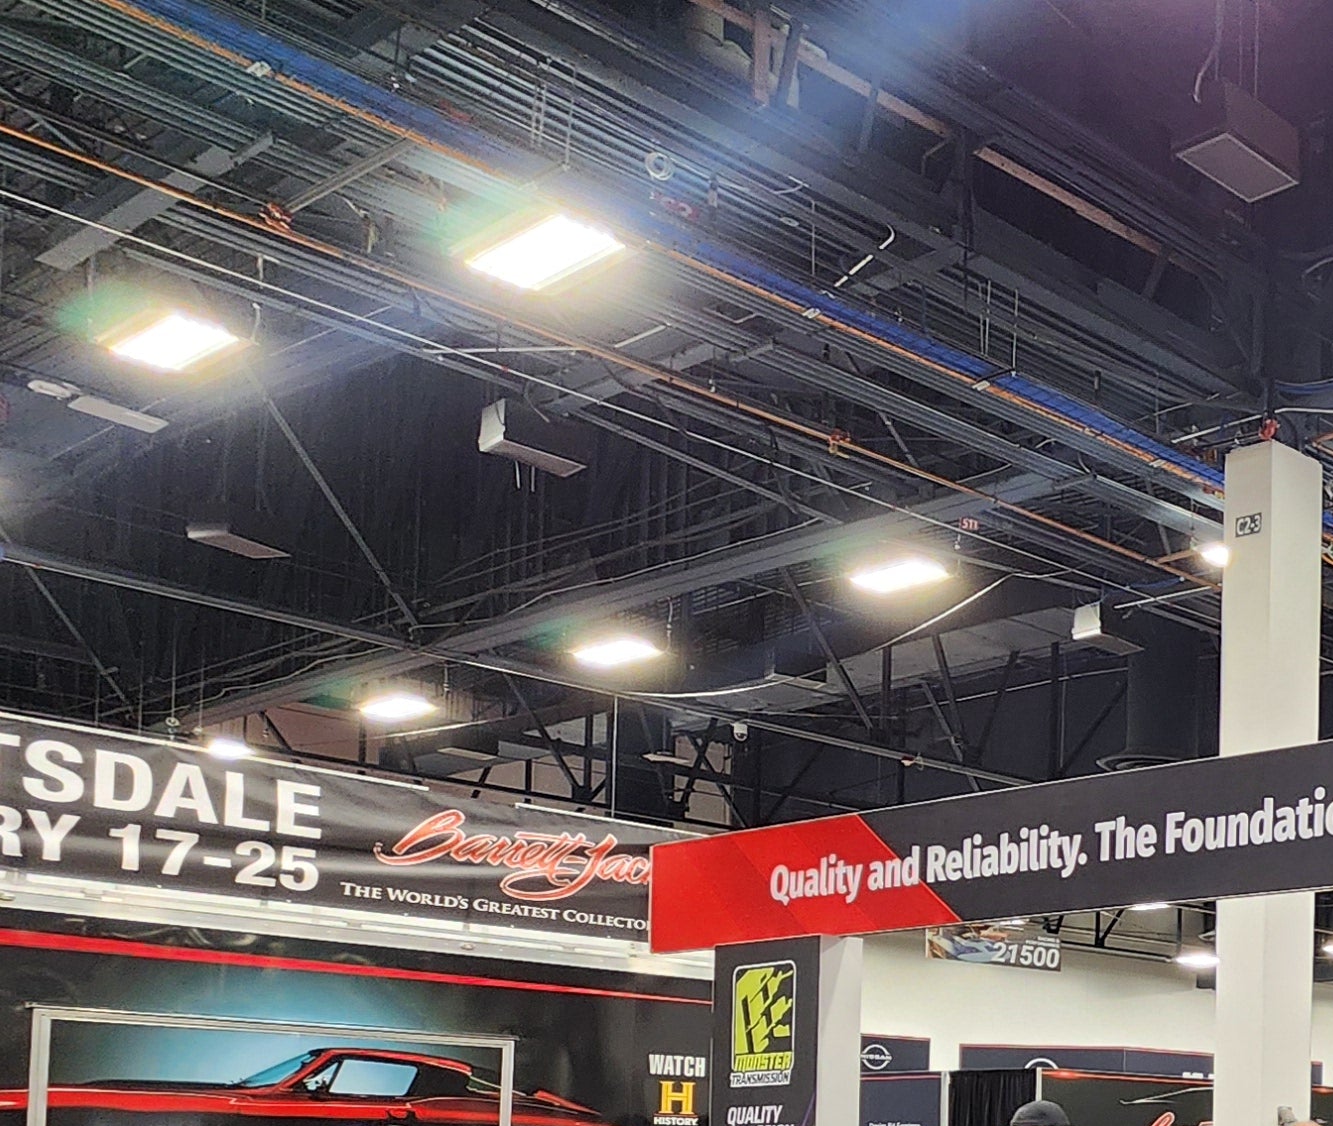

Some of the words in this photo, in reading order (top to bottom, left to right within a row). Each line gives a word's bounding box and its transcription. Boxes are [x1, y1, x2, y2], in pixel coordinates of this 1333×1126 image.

[109, 824, 319, 891] 17-25
[373, 809, 649, 901] Barrett-Jac
[770, 853, 863, 905] Quality
[867, 845, 920, 891] and
[927, 824, 1087, 883] Reliability.
[1095, 816, 1157, 862] The
[340, 882, 382, 900] THE
[473, 898, 560, 921] GREATEST
[563, 909, 650, 931] COLLECTO
[993, 942, 1060, 968] 21500
[649, 1054, 706, 1077] WATCH
[734, 1052, 793, 1072] MONSTER
[731, 1072, 790, 1087] TRANSMISSION
[658, 1080, 697, 1115] H
[653, 1116, 699, 1126] HISTORY
[727, 1105, 783, 1125] QUALITY
